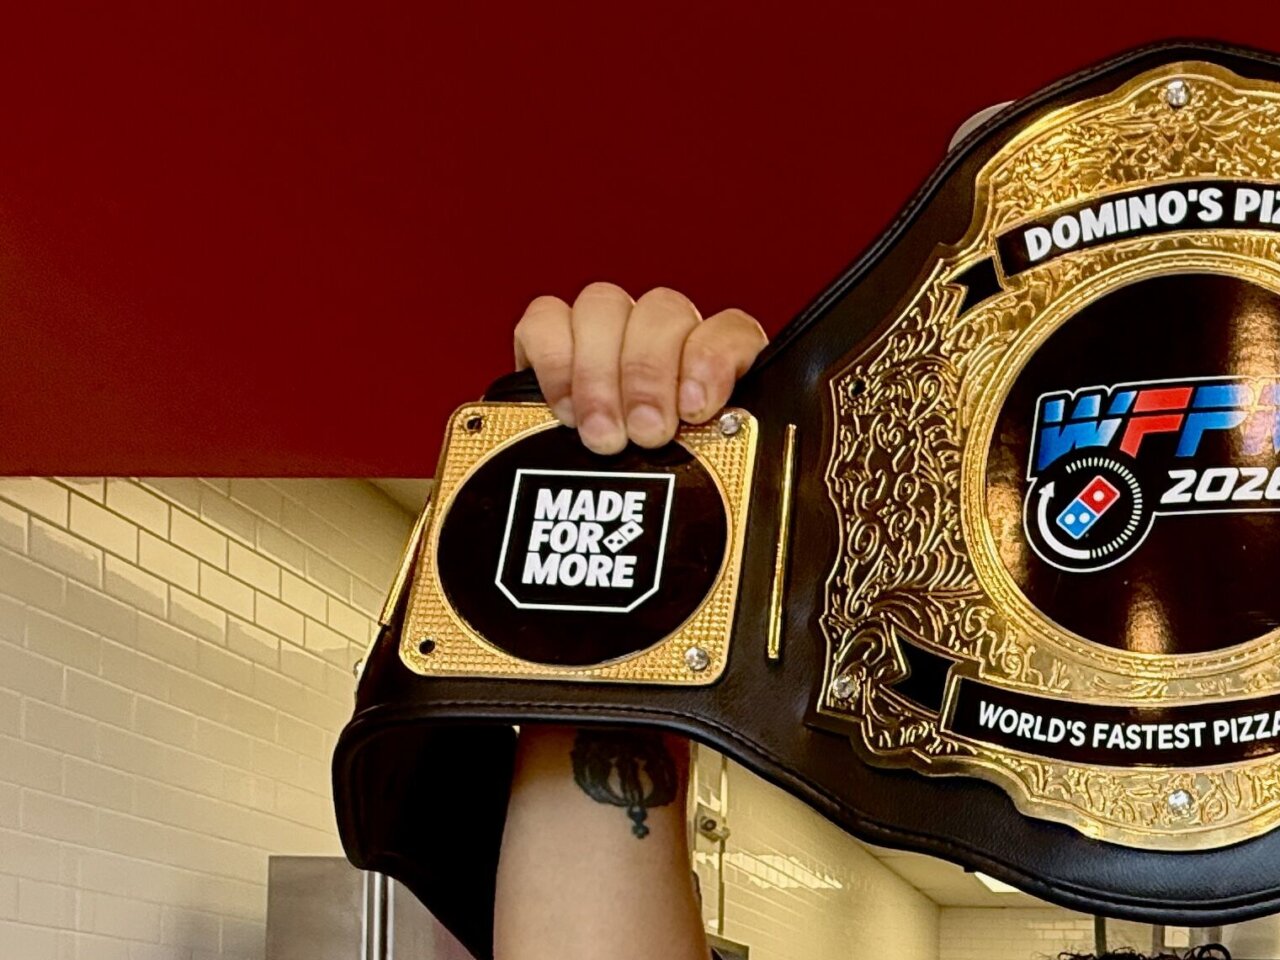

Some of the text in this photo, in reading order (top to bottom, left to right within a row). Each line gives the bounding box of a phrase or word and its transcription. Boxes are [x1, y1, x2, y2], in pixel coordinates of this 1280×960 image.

[1024, 187, 1222, 262] DOMINO'S
[534, 488, 646, 523] MADE
[527, 520, 604, 553] FOR
[521, 552, 637, 588] MORE
[978, 700, 1086, 747] WORLD'S
[1091, 721, 1204, 750] FASTEST
